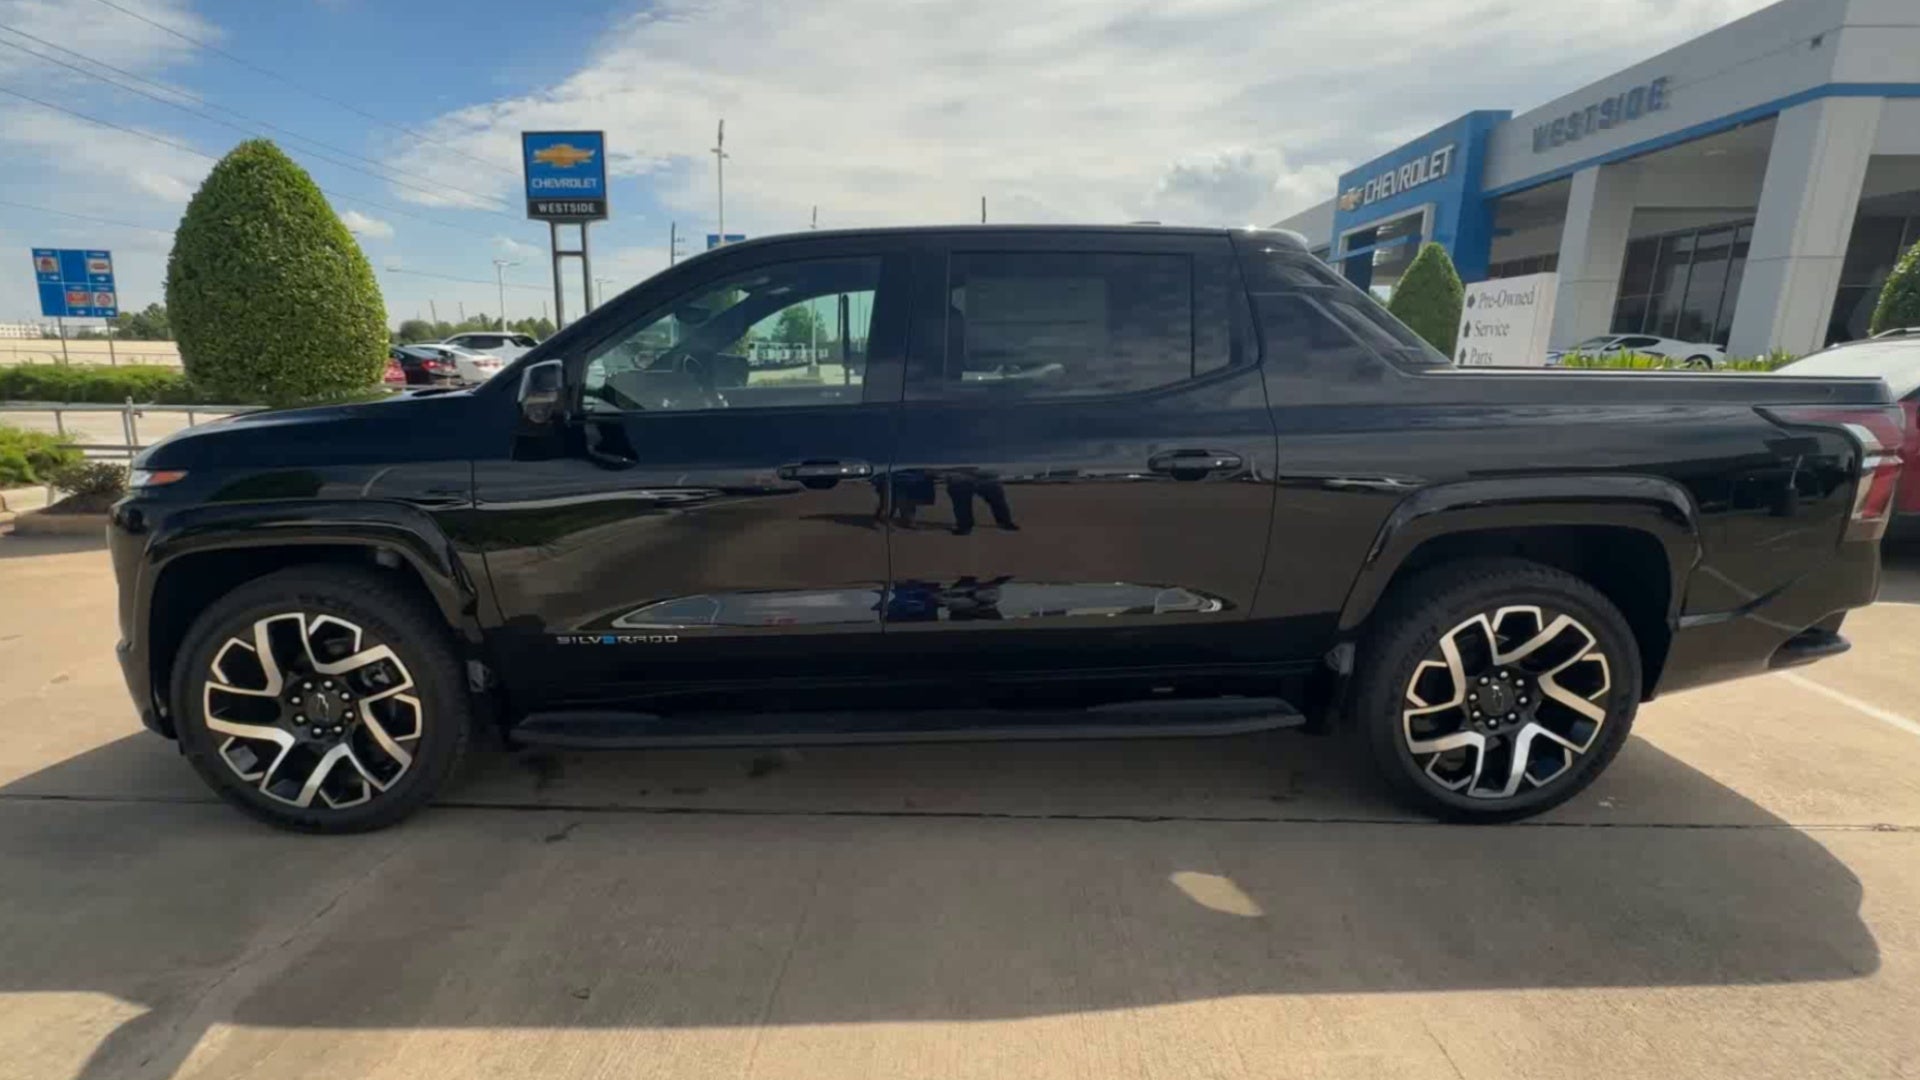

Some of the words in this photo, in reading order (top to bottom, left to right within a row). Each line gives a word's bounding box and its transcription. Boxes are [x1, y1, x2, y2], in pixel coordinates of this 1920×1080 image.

[1533, 76, 1670, 153] WESTSIDE
[532, 177, 597, 189] CHEVROLET
[1363, 143, 1455, 206] CHEVROLET
[538, 202, 595, 213] WESTSIDE
[1478, 284, 1535, 309] Pre-Owned
[1474, 319, 1510, 337] Service
[1470, 347, 1493, 365] Parts
[557, 635, 678, 645] SILVERADO
